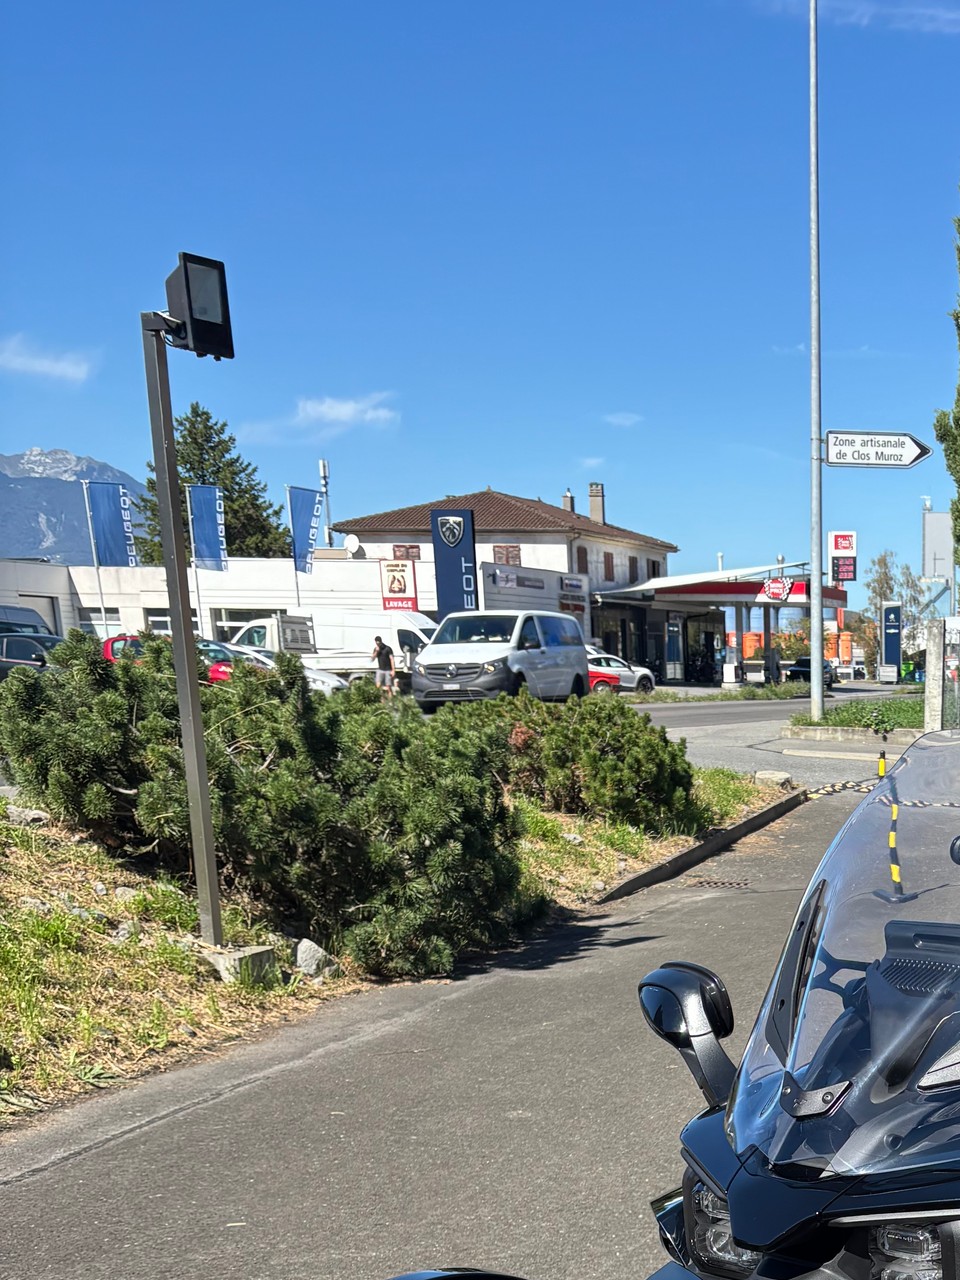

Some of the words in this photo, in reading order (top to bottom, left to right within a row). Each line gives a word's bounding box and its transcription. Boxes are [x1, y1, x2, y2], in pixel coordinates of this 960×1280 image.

[833, 436, 856, 447] Zone
[860, 437, 906, 449] artisanale
[835, 450, 847, 460] de
[852, 450, 871, 461] Clos
[875, 451, 903, 462] Muroz
[119, 485, 137, 567] PEUGEOT
[215, 488, 229, 572] PEUGEOT
[305, 492, 324, 575] PEUGEOT
[385, 600, 413, 608] LAVAGE
[461, 556, 476, 609] EOT
